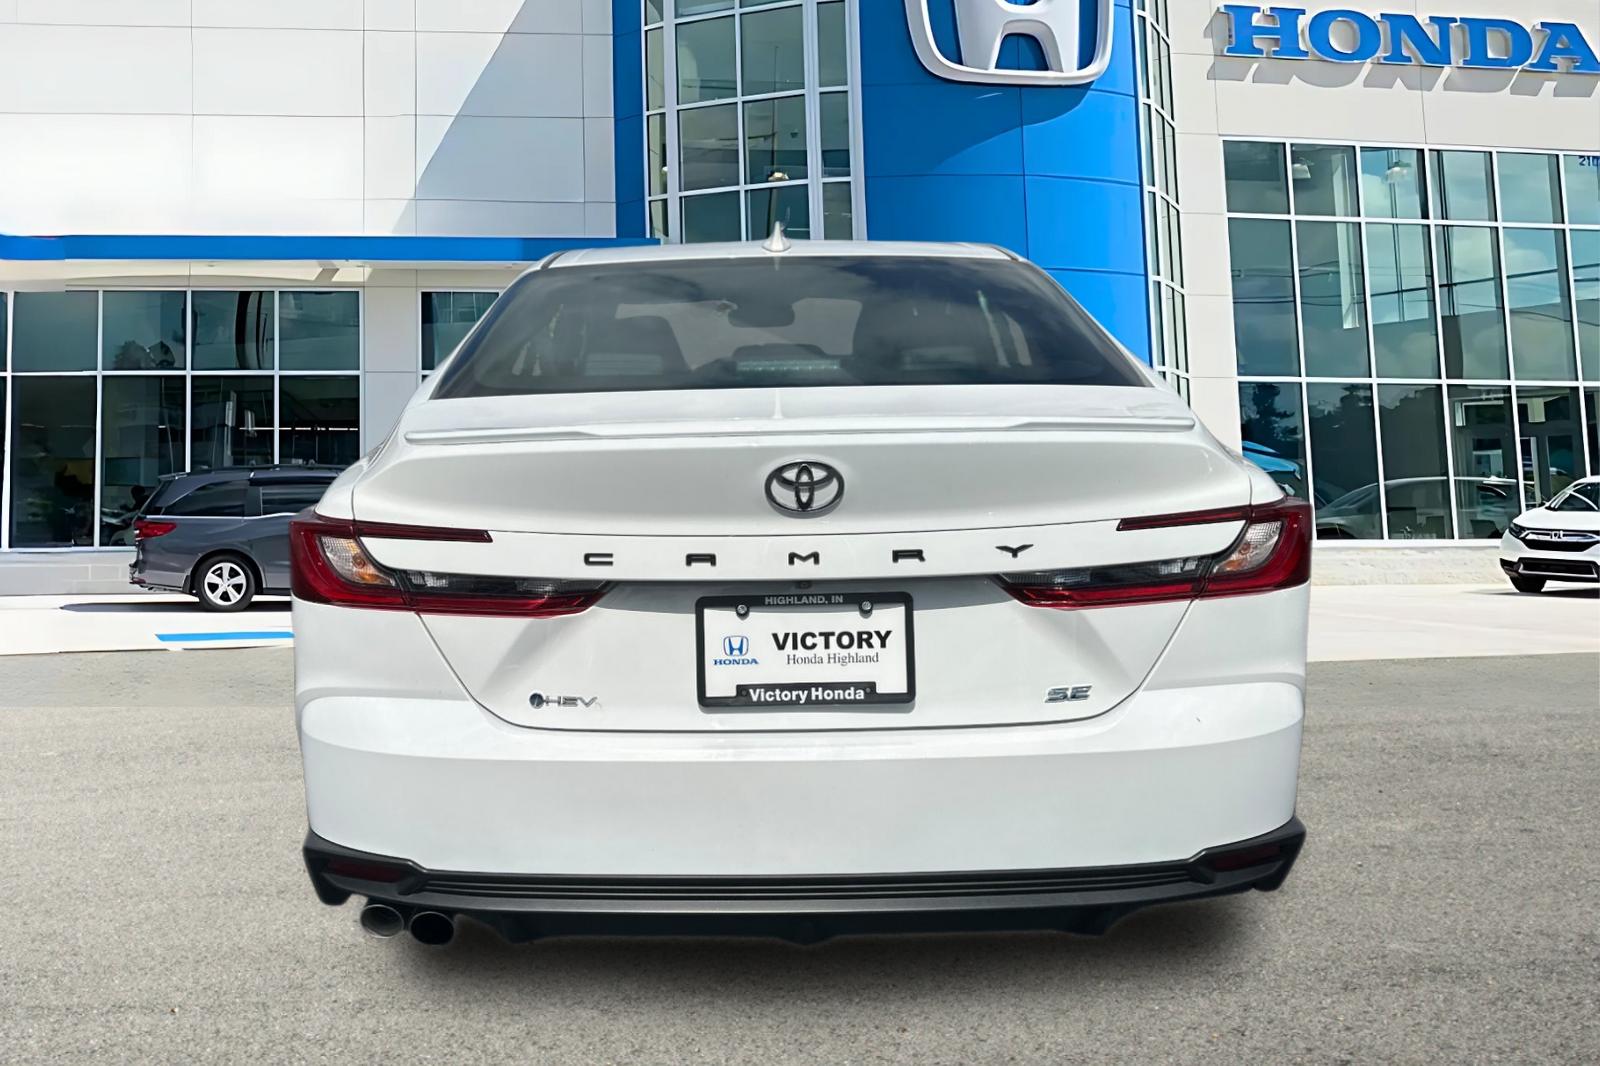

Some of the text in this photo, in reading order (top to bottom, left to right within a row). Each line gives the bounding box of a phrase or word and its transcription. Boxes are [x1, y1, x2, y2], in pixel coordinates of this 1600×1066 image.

[1222, 4, 1600, 73] HONDA
[583, 543, 1035, 567] CAMRY
[831, 595, 844, 604] IN
[771, 630, 893, 651] VICTORY
[713, 658, 760, 666] HONDA
[786, 652, 880, 667] Honda Highland
[748, 687, 865, 704] Victory Honda
[1044, 685, 1092, 703] SE
